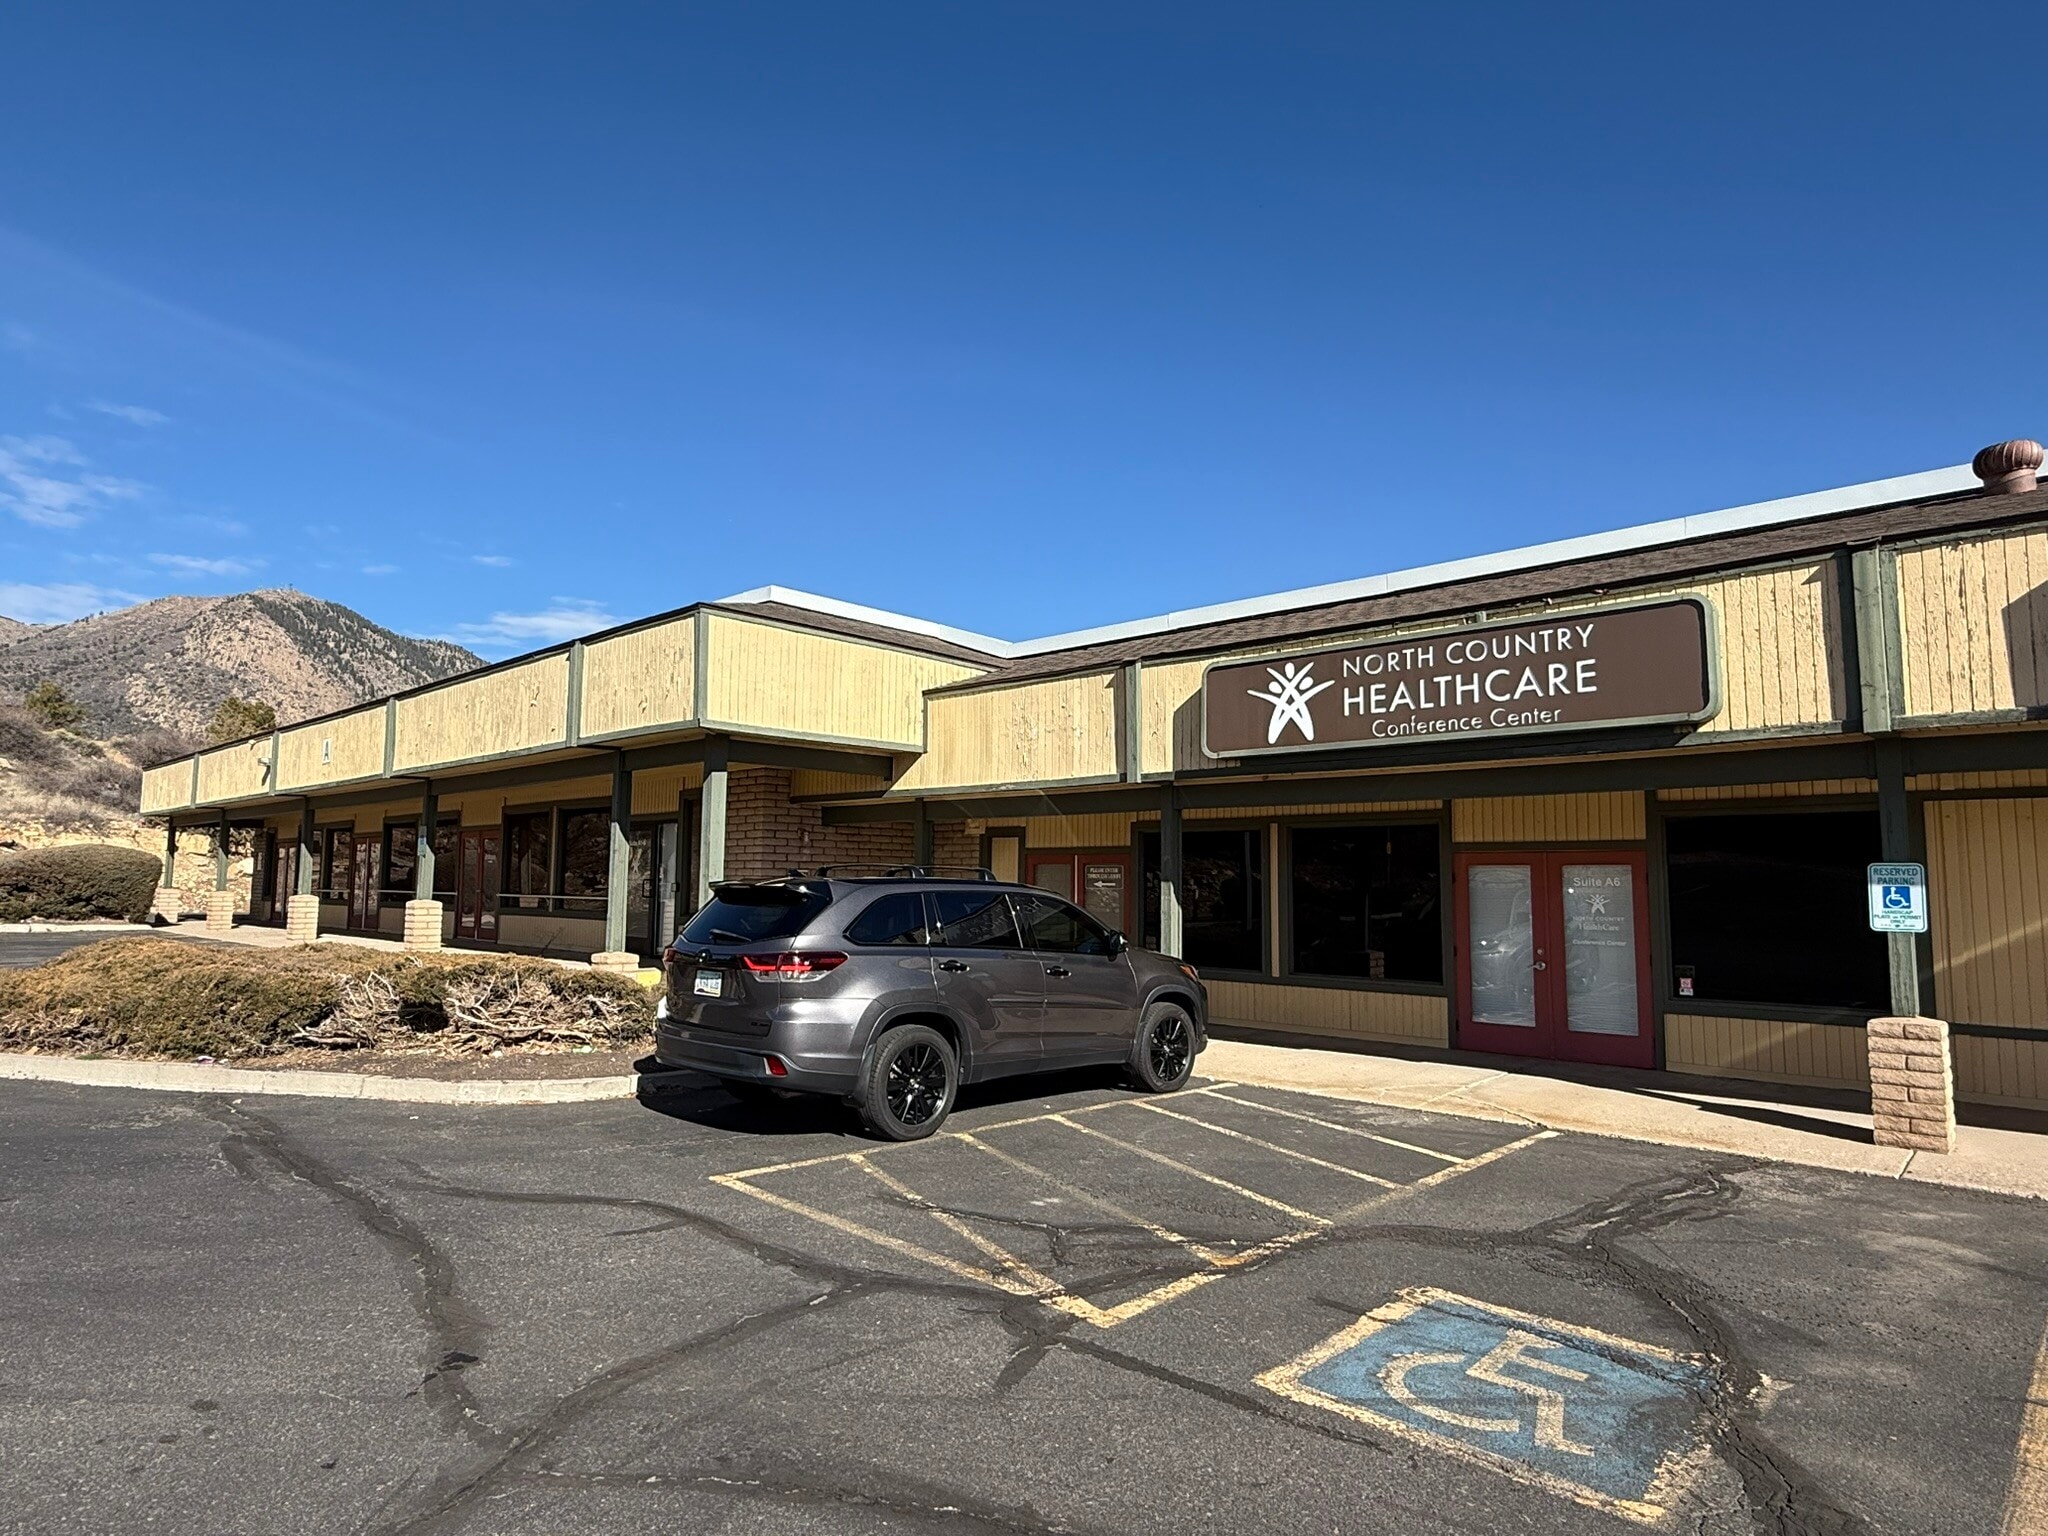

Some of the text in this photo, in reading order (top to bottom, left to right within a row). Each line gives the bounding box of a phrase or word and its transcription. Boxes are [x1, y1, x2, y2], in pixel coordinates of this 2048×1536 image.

[1343, 624, 1594, 678] NORTH COUNTRY
[1343, 659, 1598, 716] HEALTHCARE
[1372, 708, 1562, 737] Conference Center
[1873, 868, 1918, 876] RESERVED
[1877, 877, 1915, 885] PARKING
[1573, 877, 1621, 887] Suite A6
